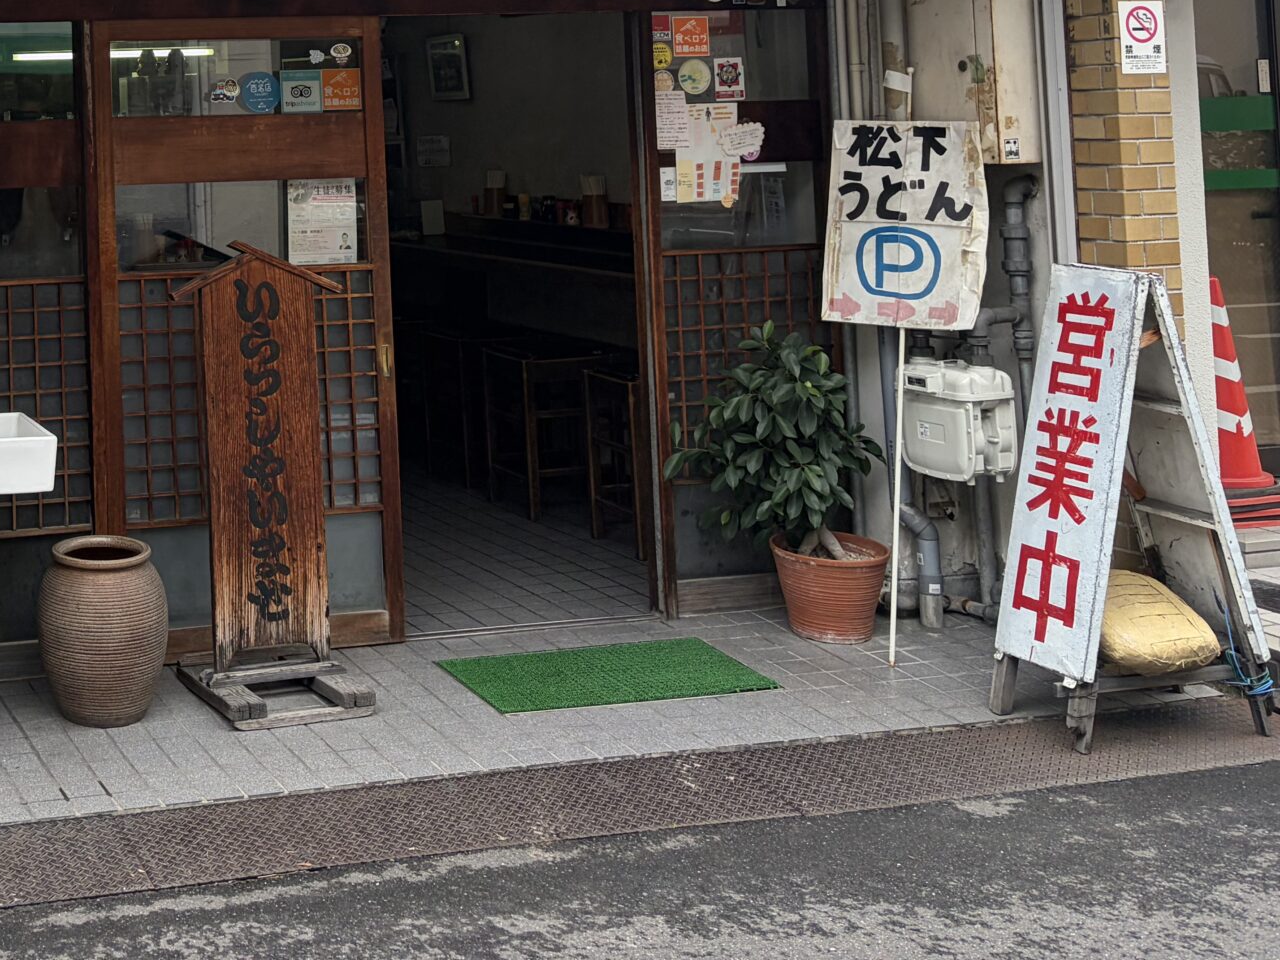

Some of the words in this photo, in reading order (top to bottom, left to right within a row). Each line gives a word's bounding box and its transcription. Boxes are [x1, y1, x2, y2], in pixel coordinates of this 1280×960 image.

[847, 124, 946, 170] 松下
[838, 170, 974, 222] うどん
[1011, 290, 1115, 643] 営業中
